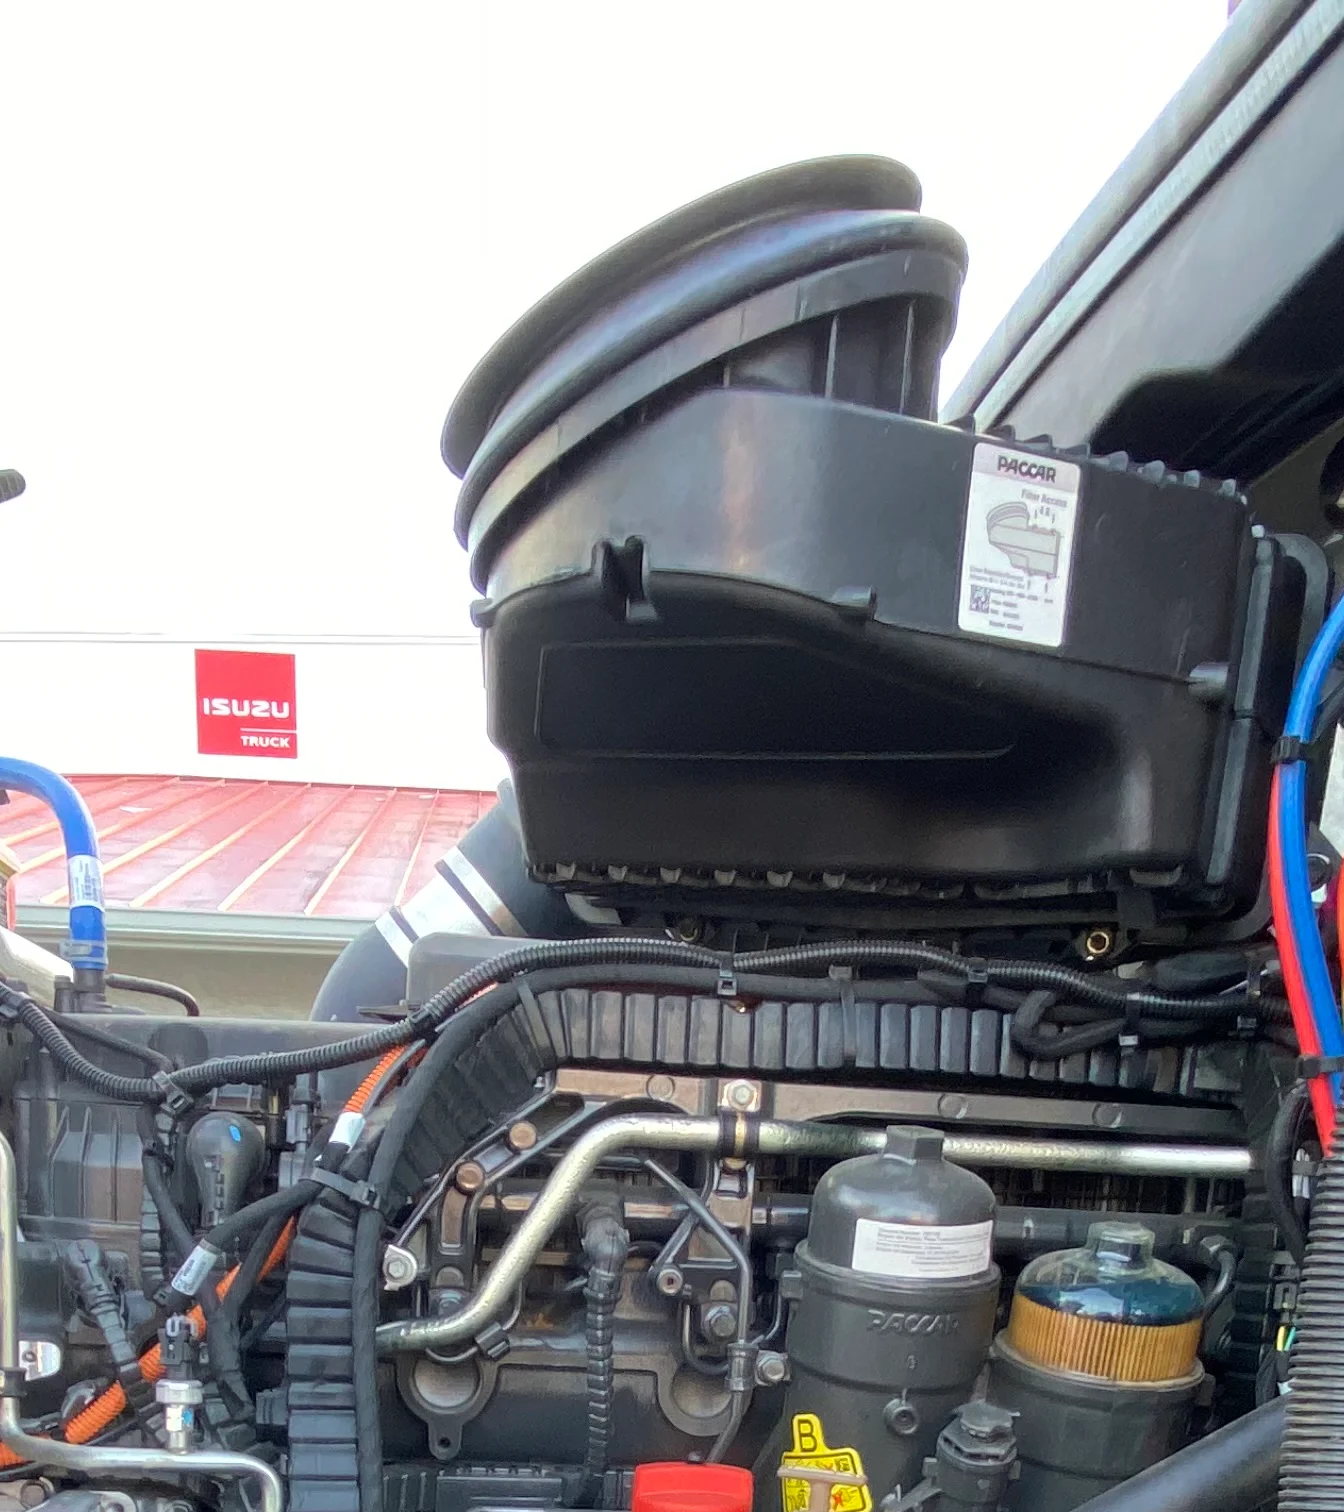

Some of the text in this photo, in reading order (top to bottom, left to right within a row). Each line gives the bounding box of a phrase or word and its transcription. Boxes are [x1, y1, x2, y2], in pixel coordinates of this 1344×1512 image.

[997, 455, 1056, 483] PACCAR
[203, 698, 289, 718] ISUZU
[241, 736, 290, 748] TRUCK
[798, 1419, 817, 1452] B
